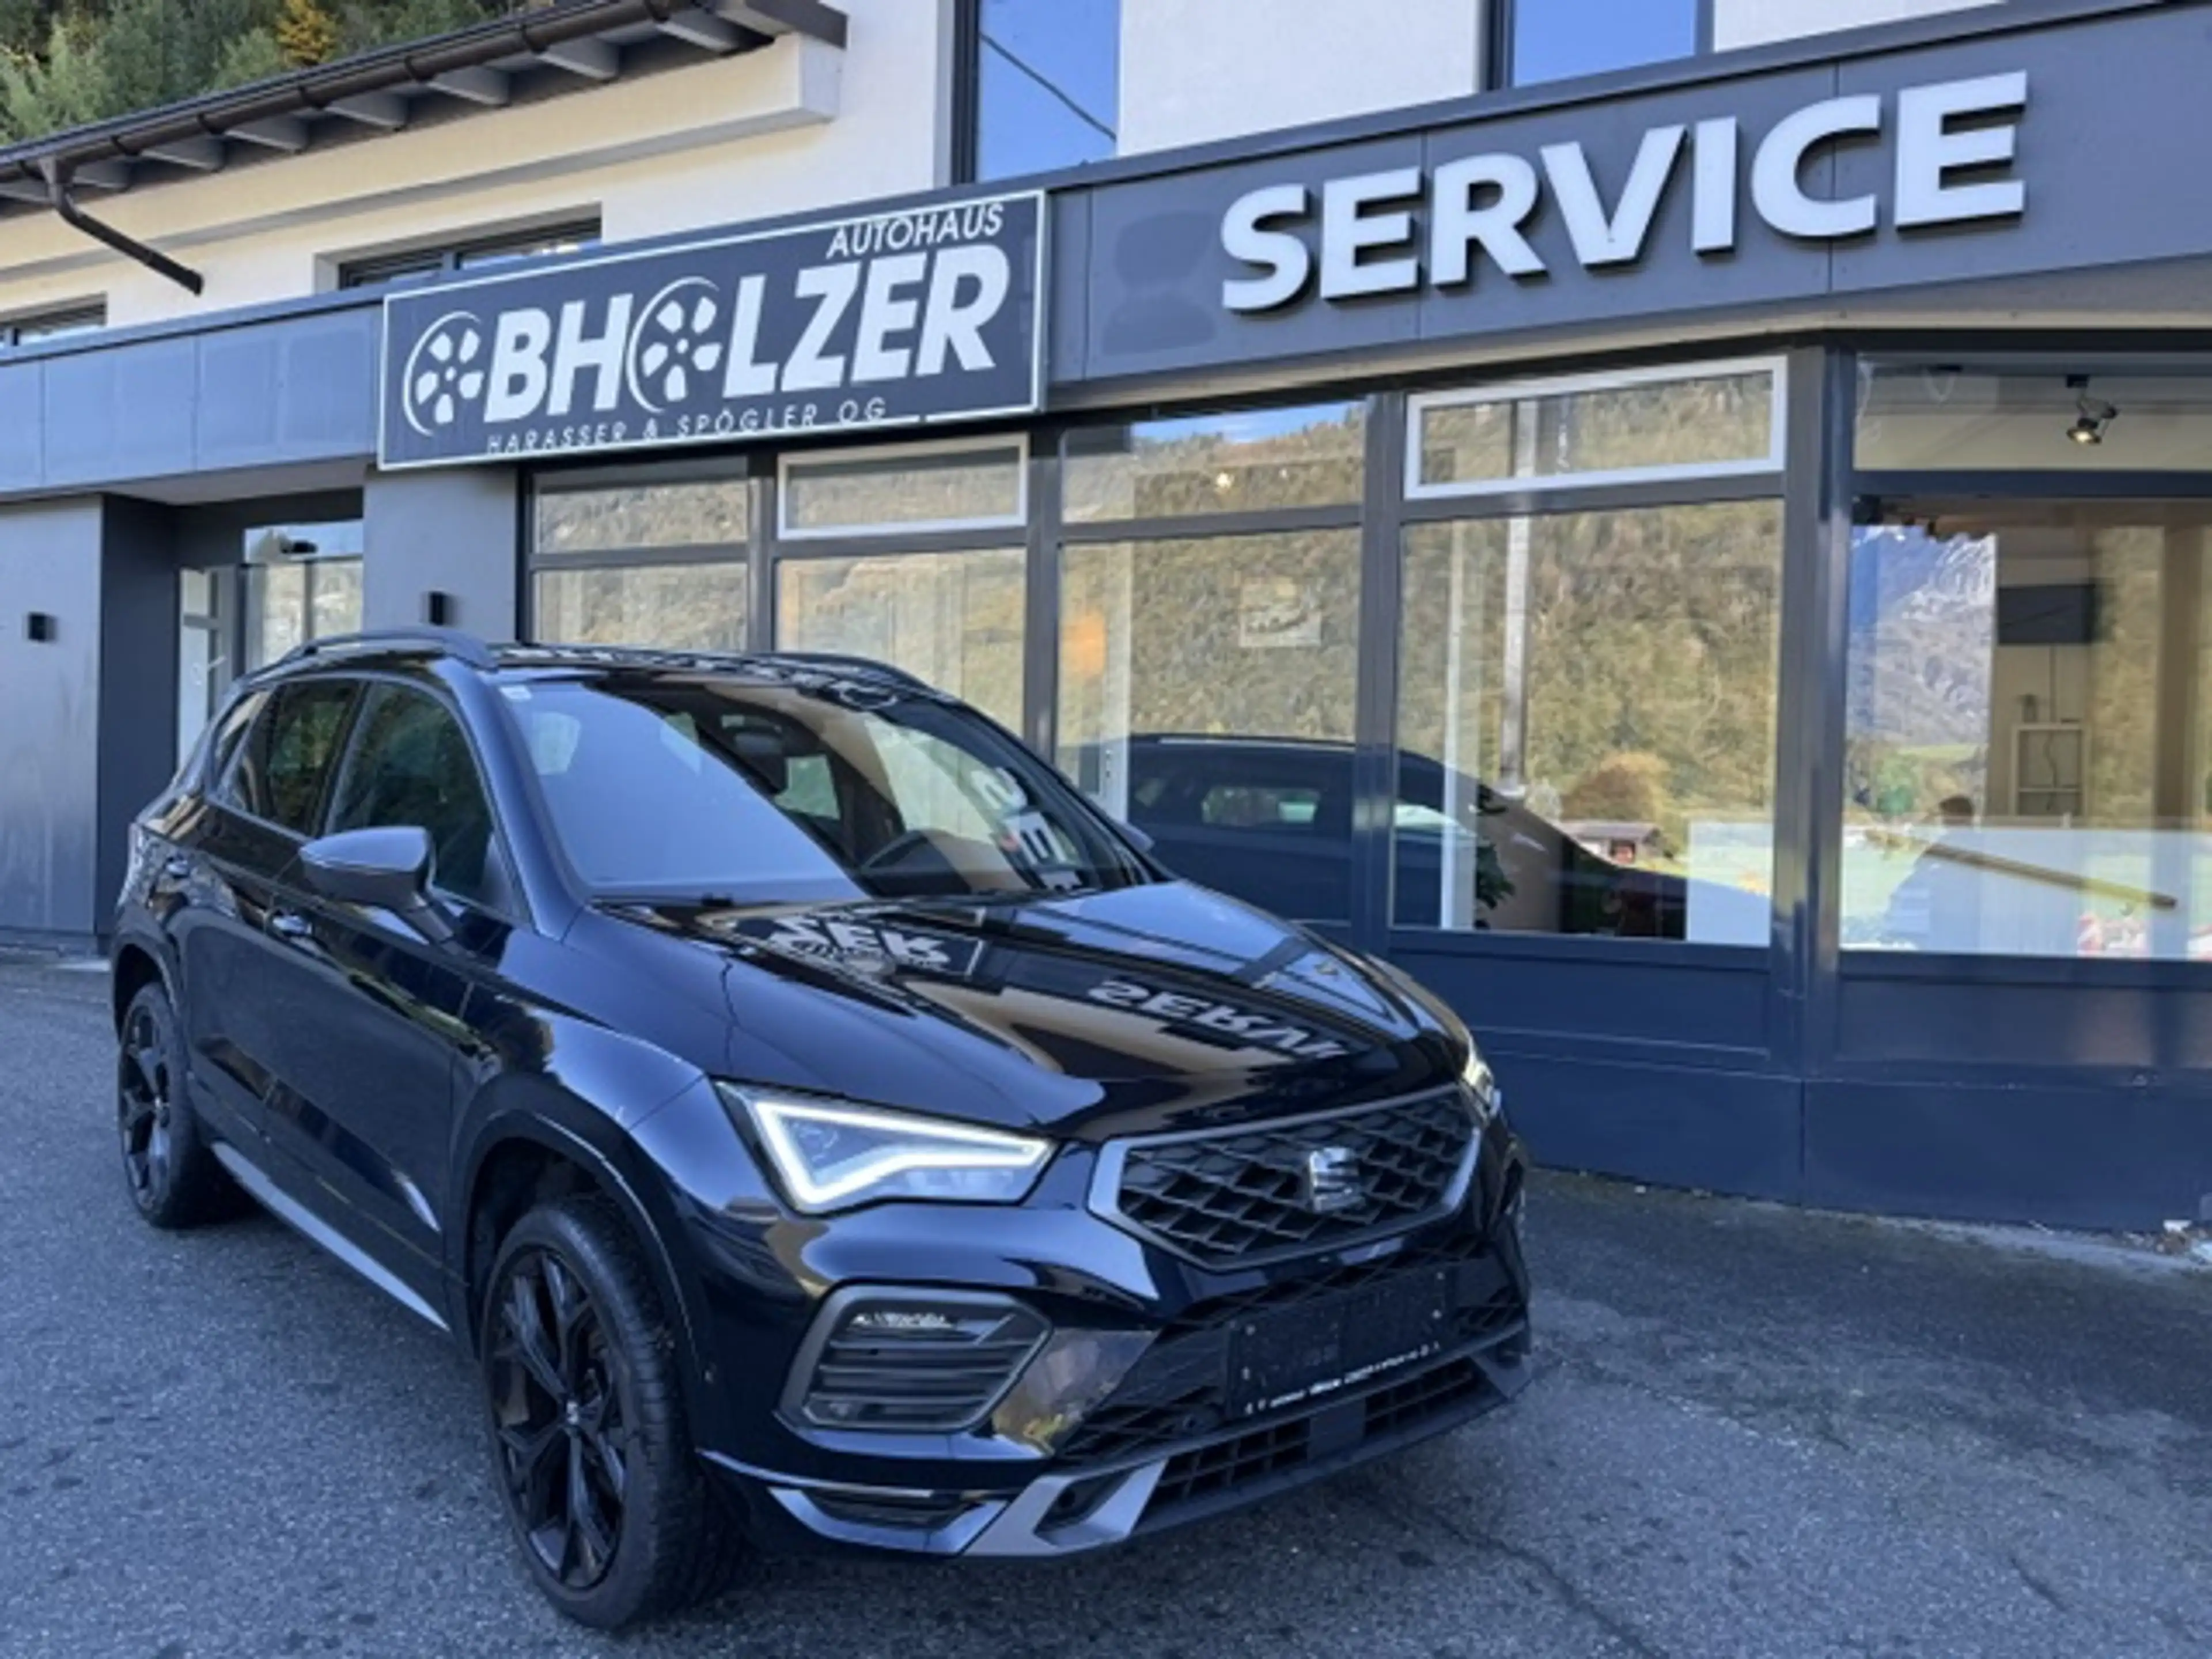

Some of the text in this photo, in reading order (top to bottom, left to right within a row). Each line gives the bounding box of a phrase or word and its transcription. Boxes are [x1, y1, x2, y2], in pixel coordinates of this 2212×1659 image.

[1220, 70, 2028, 311] SERVICE
[825, 202, 1004, 259] AUTOHAUS
[487, 421, 627, 455] HARASSER
[838, 397, 887, 425] OG
